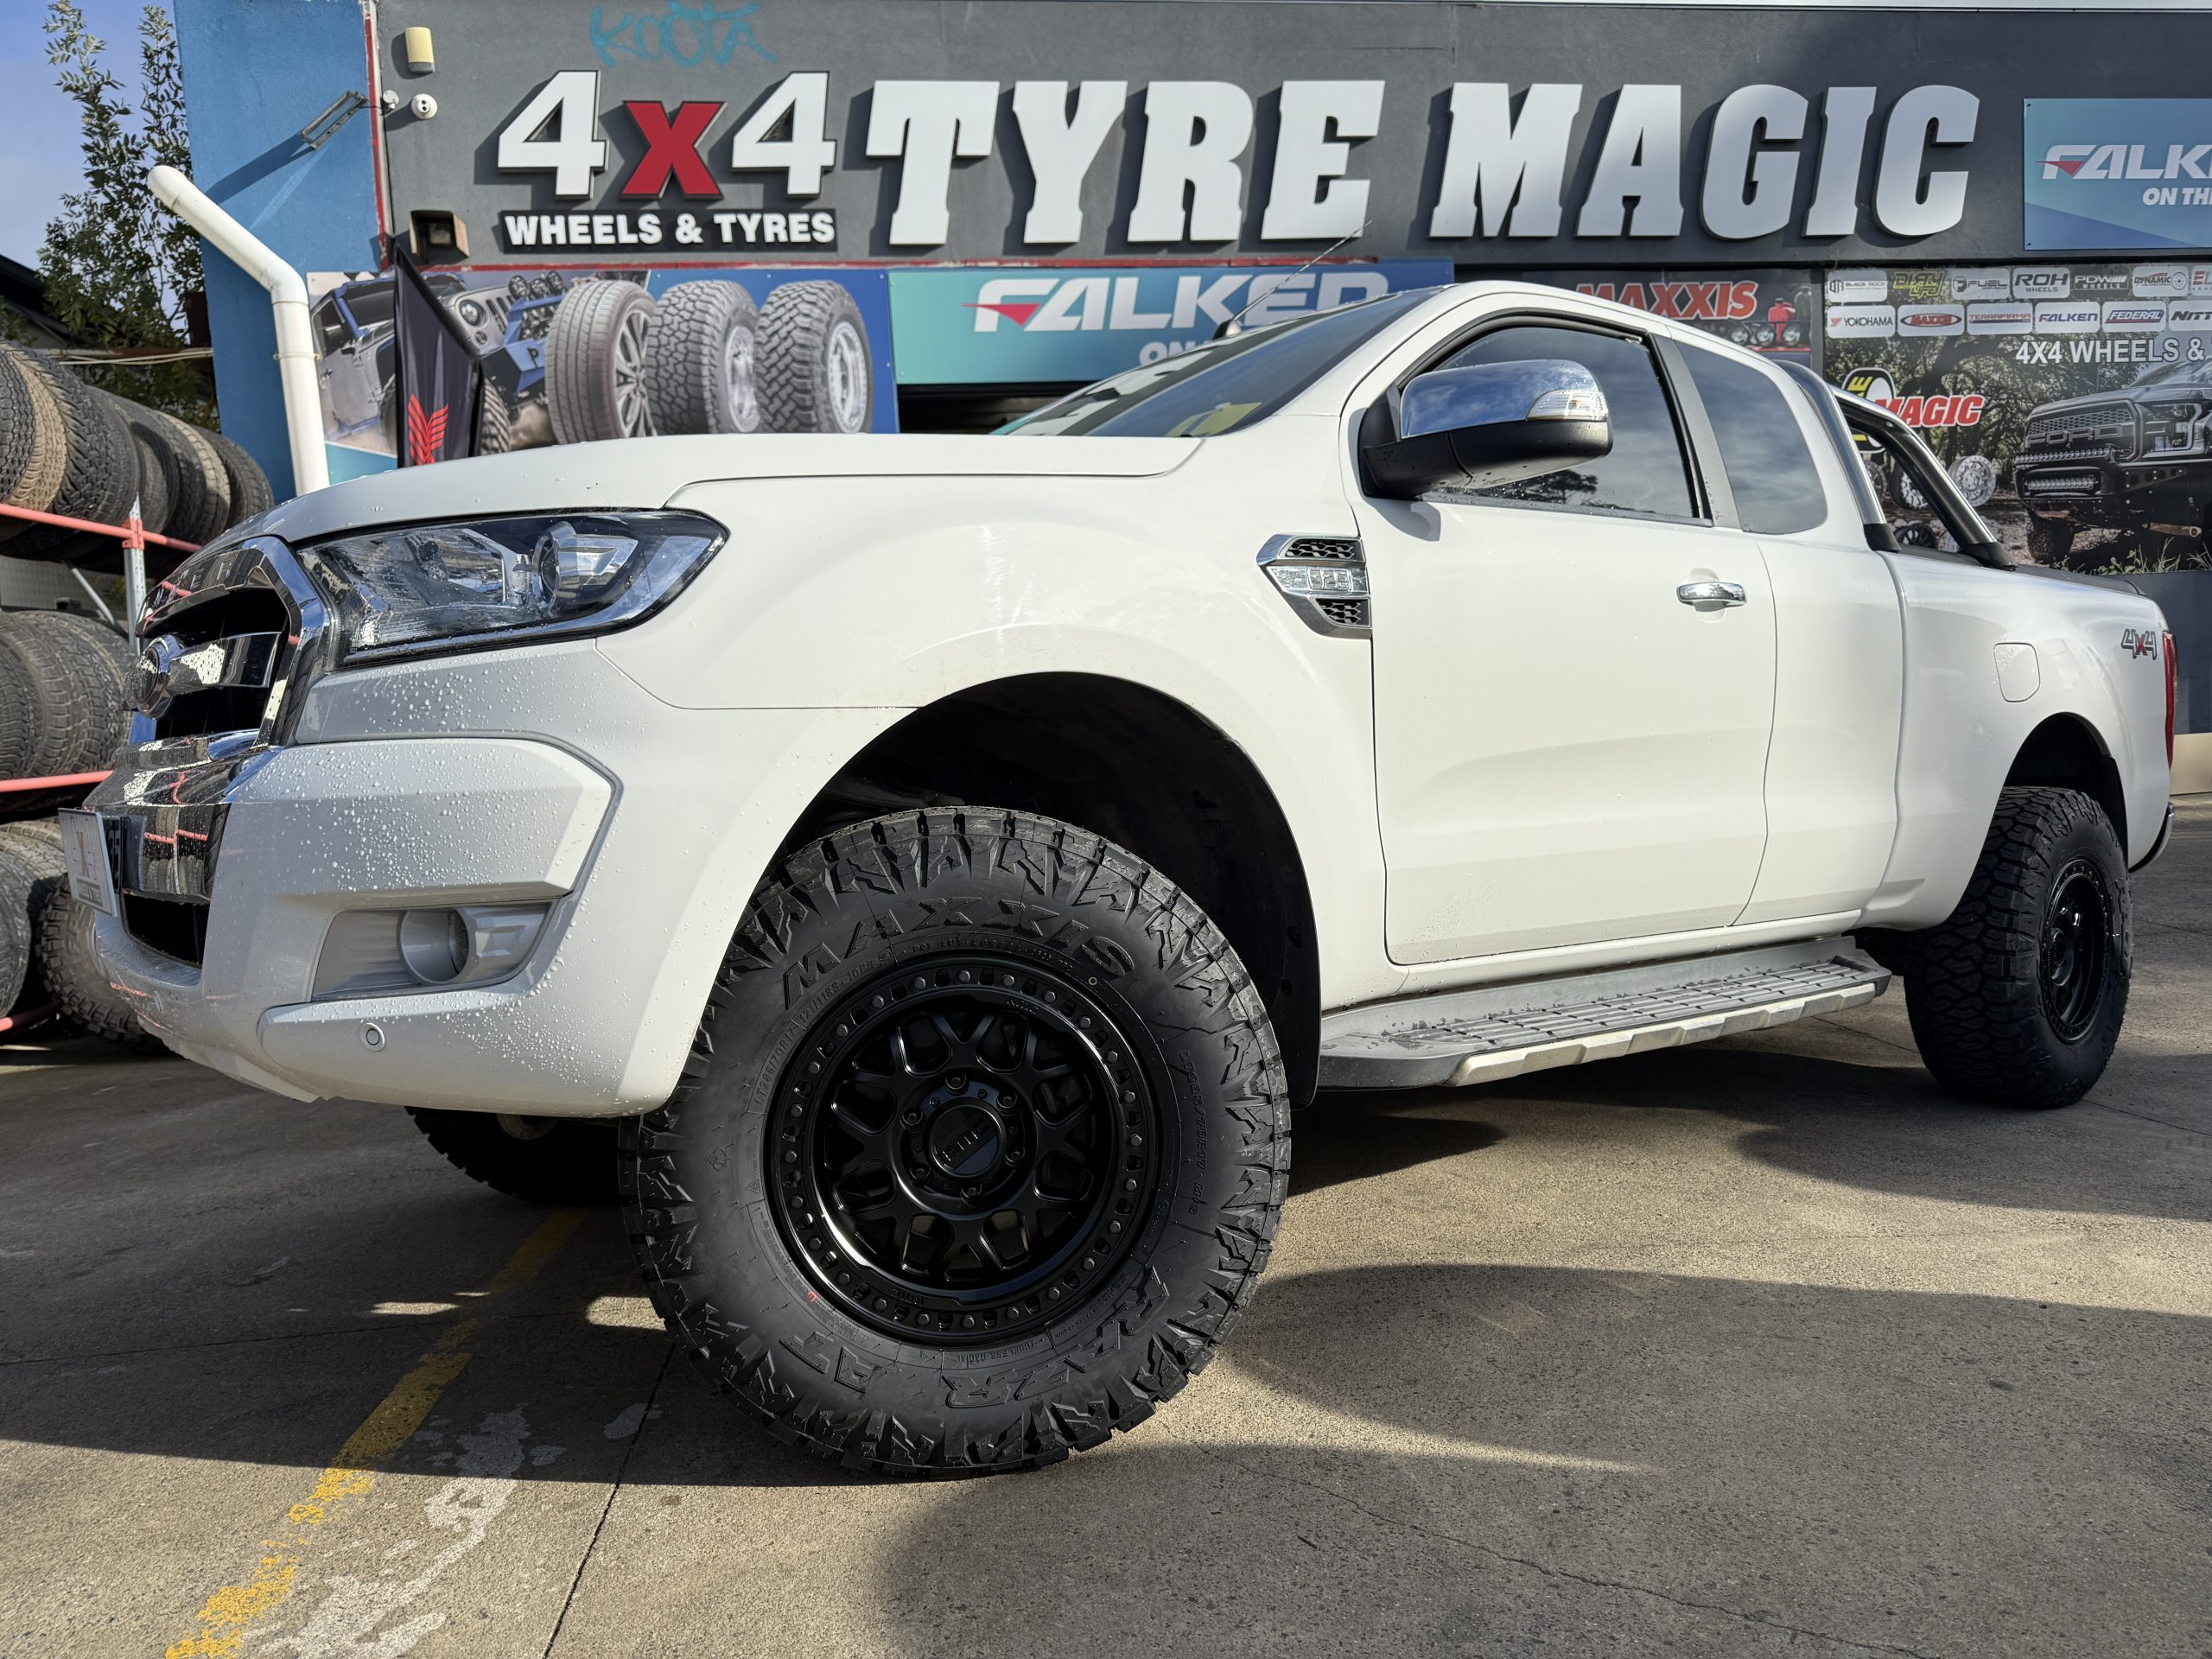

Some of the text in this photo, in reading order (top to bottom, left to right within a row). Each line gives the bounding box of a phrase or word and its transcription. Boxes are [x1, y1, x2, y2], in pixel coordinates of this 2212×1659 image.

[866, 80, 1385, 245] TYRE
[1429, 82, 1980, 240] MAGIC
[2037, 145, 2212, 179] FALK
[2142, 188, 2212, 206] ON TH
[505, 213, 835, 245] WHEELS & TYRES
[2015, 274, 2068, 286] ROH
[2133, 276, 2171, 285] DYNAMIC
[1844, 317, 1893, 327] YOKOHAMA
[1910, 315, 1953, 325] MAXXIS
[2039, 313, 2098, 322] FALKEN
[2109, 311, 2162, 321] FEDERAL
[2016, 336, 2206, 364] 4X4 WHEELS &
[785, 896, 1135, 1009] MAXXIS
